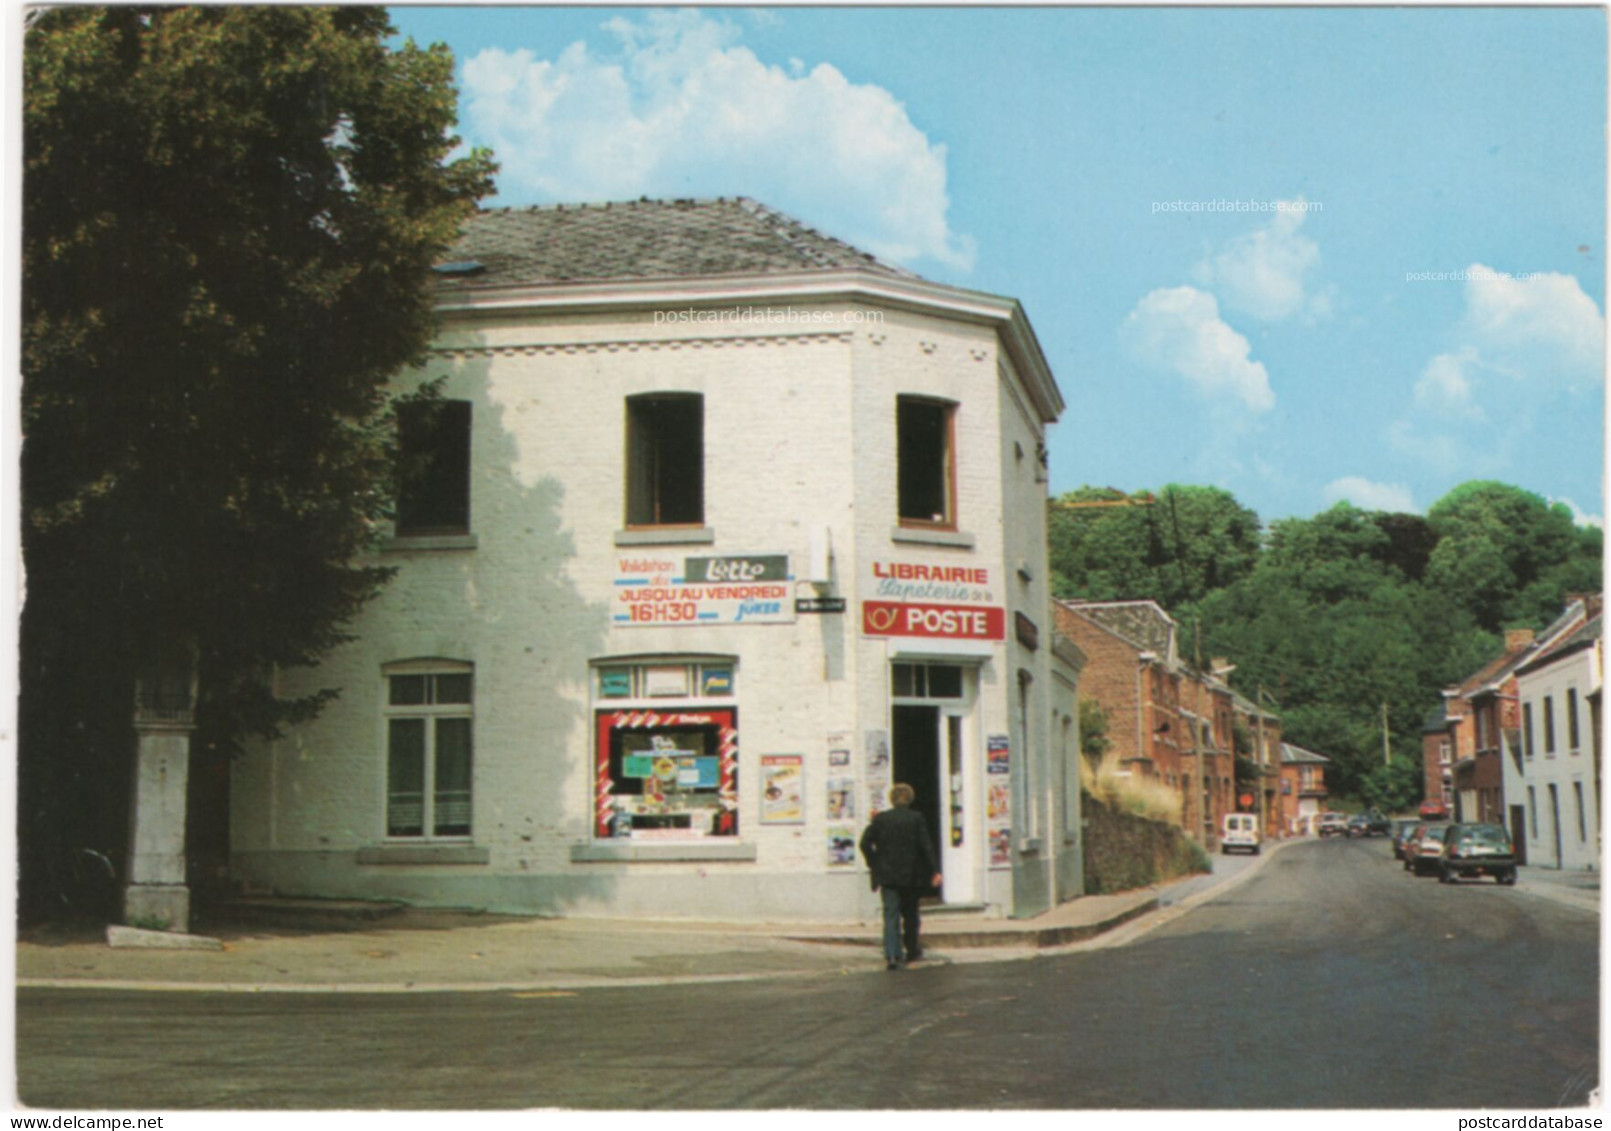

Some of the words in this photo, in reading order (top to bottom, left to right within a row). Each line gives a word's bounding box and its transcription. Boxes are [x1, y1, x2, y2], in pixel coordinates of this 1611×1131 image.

[619, 558, 675, 573] Validation
[706, 559, 765, 581] Lotto
[873, 562, 988, 584] LIBRAIRIE
[706, 586, 787, 600] VENDREDI
[876, 576, 969, 601] Papeterie
[629, 602, 697, 622] 16H30
[907, 608, 987, 634] POSTE
